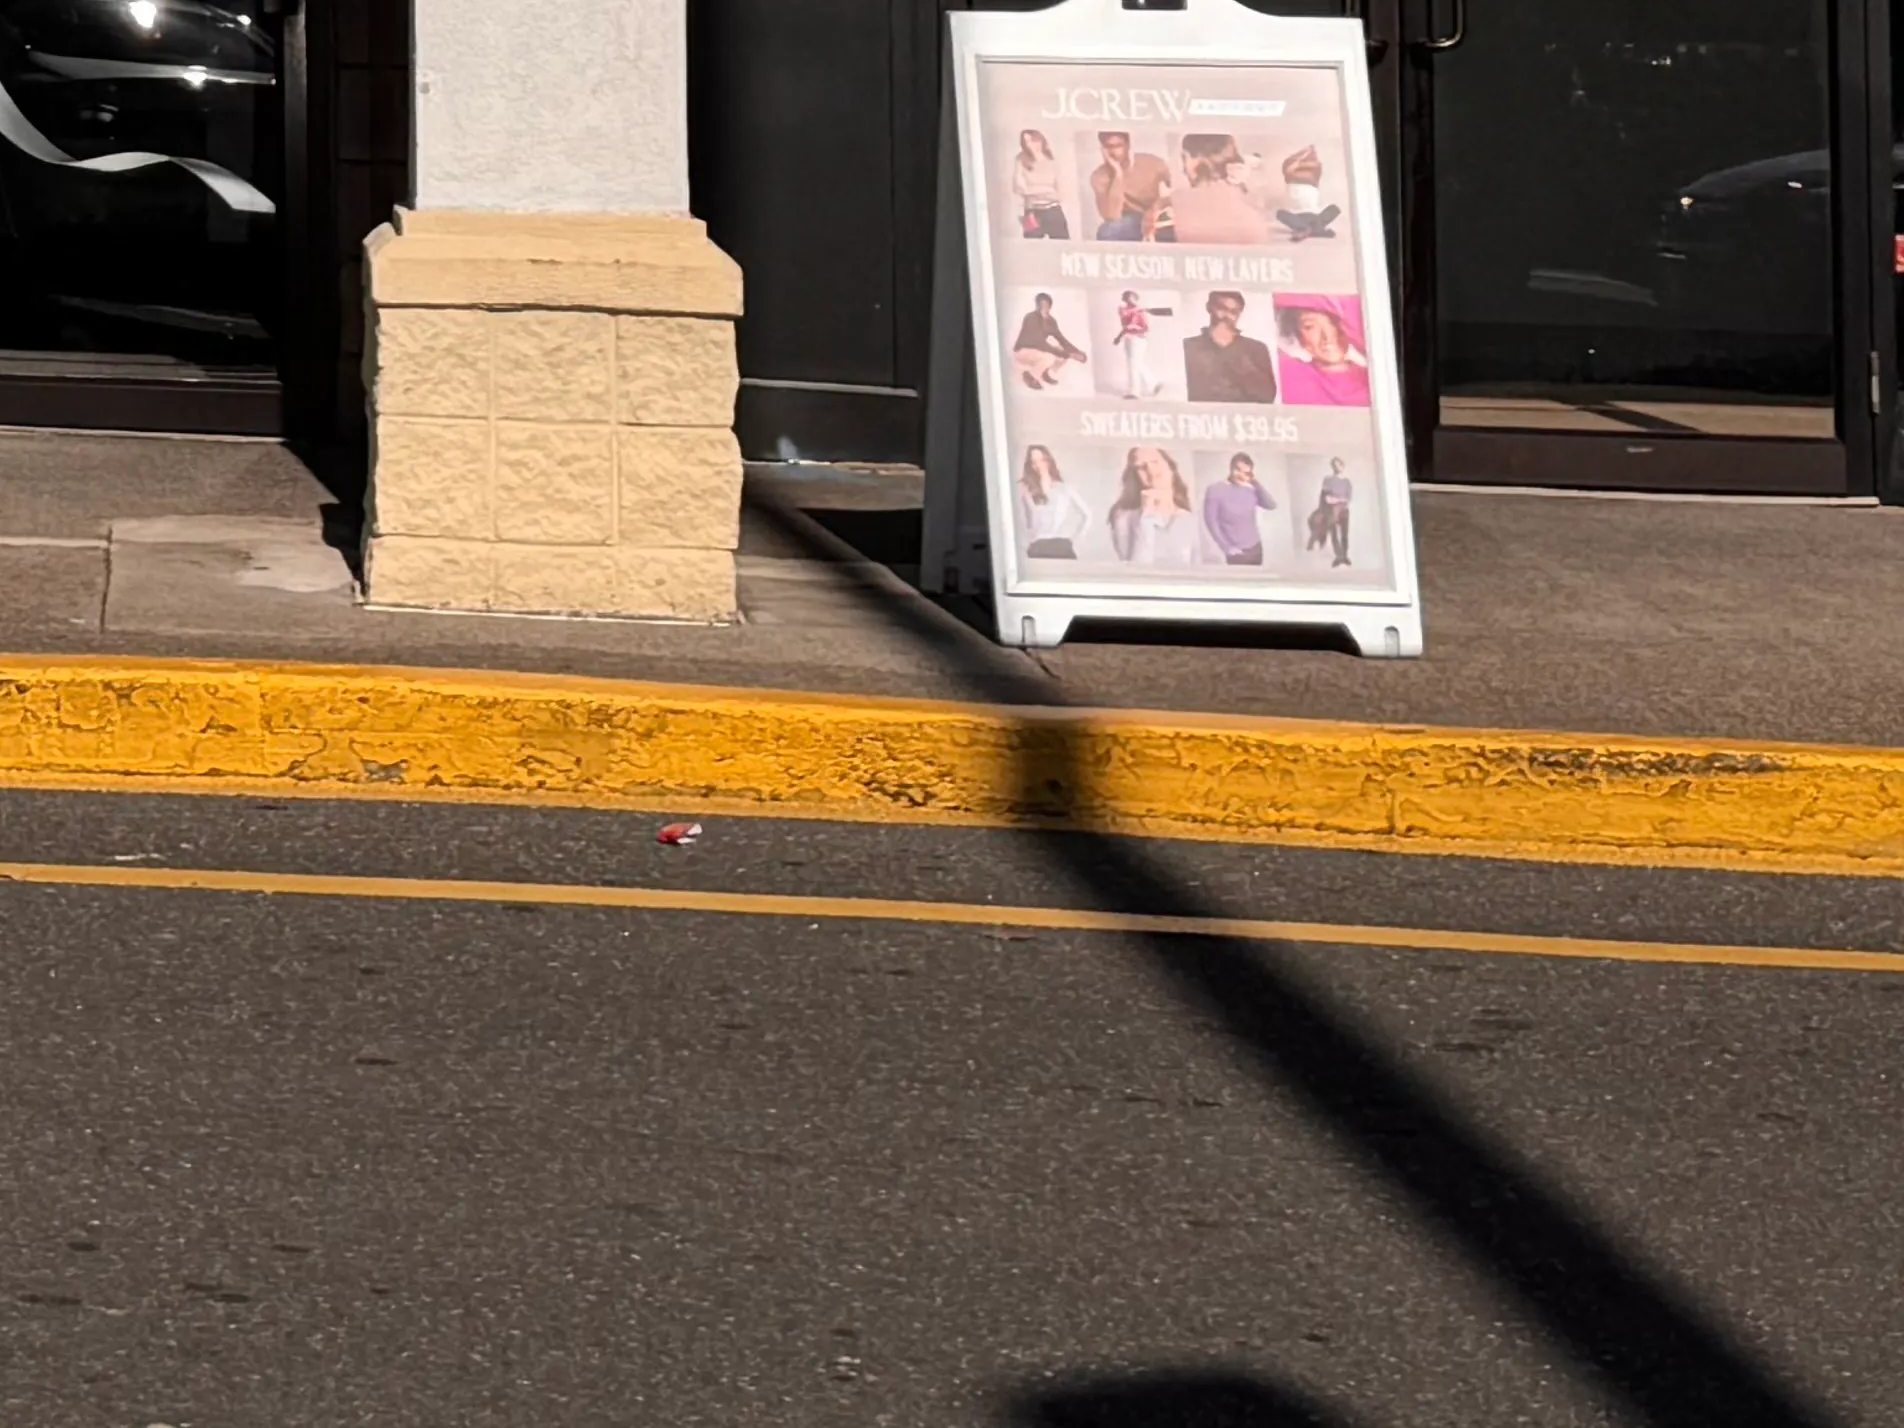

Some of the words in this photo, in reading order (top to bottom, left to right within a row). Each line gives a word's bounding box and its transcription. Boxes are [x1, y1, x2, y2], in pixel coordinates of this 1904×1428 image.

[1060, 251, 1102, 278] NEW
[1184, 255, 1224, 282] NEW
[1228, 256, 1295, 285] LAYERS
[1079, 410, 1175, 440] SWEATERS
[1177, 412, 1229, 441] FROM
